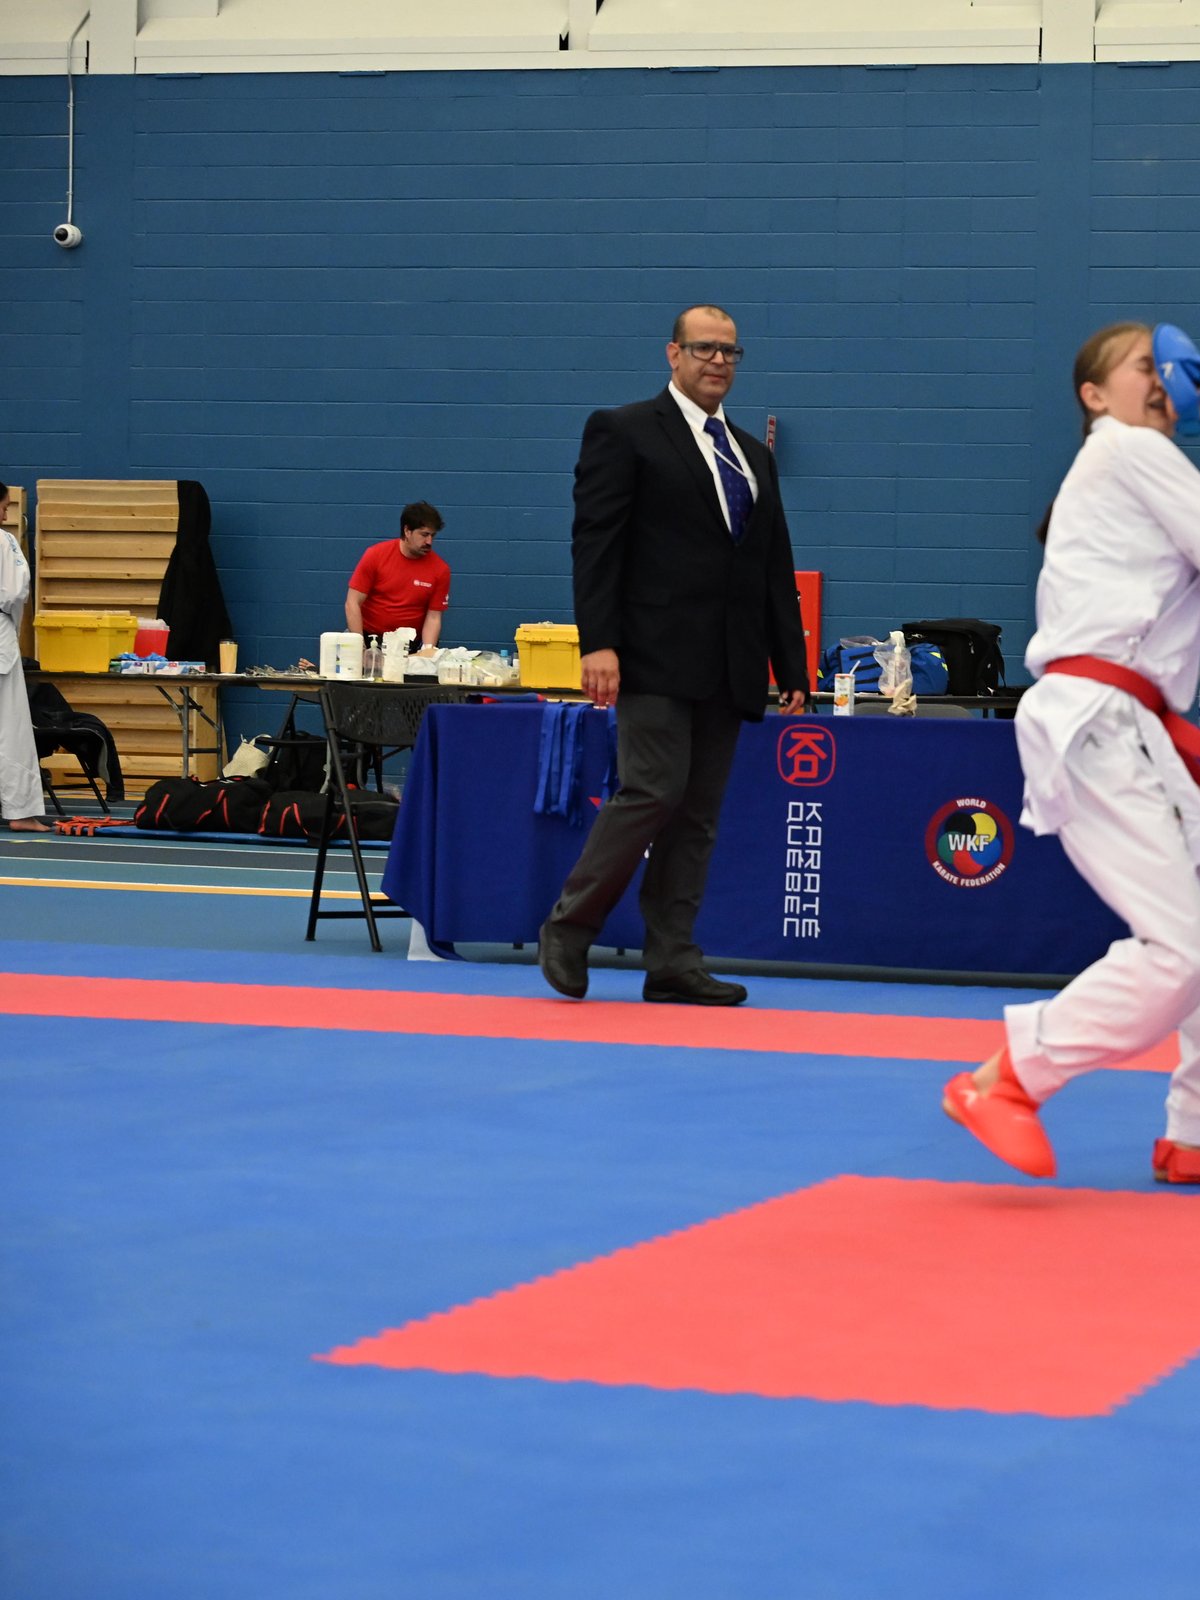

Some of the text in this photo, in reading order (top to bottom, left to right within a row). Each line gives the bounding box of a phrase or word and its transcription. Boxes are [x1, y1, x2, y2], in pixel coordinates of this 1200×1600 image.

[956, 798, 987, 809] WORLD
[948, 834, 990, 852] WKF
[932, 860, 959, 885] KARATE
[960, 862, 1006, 887] FEDERATION
